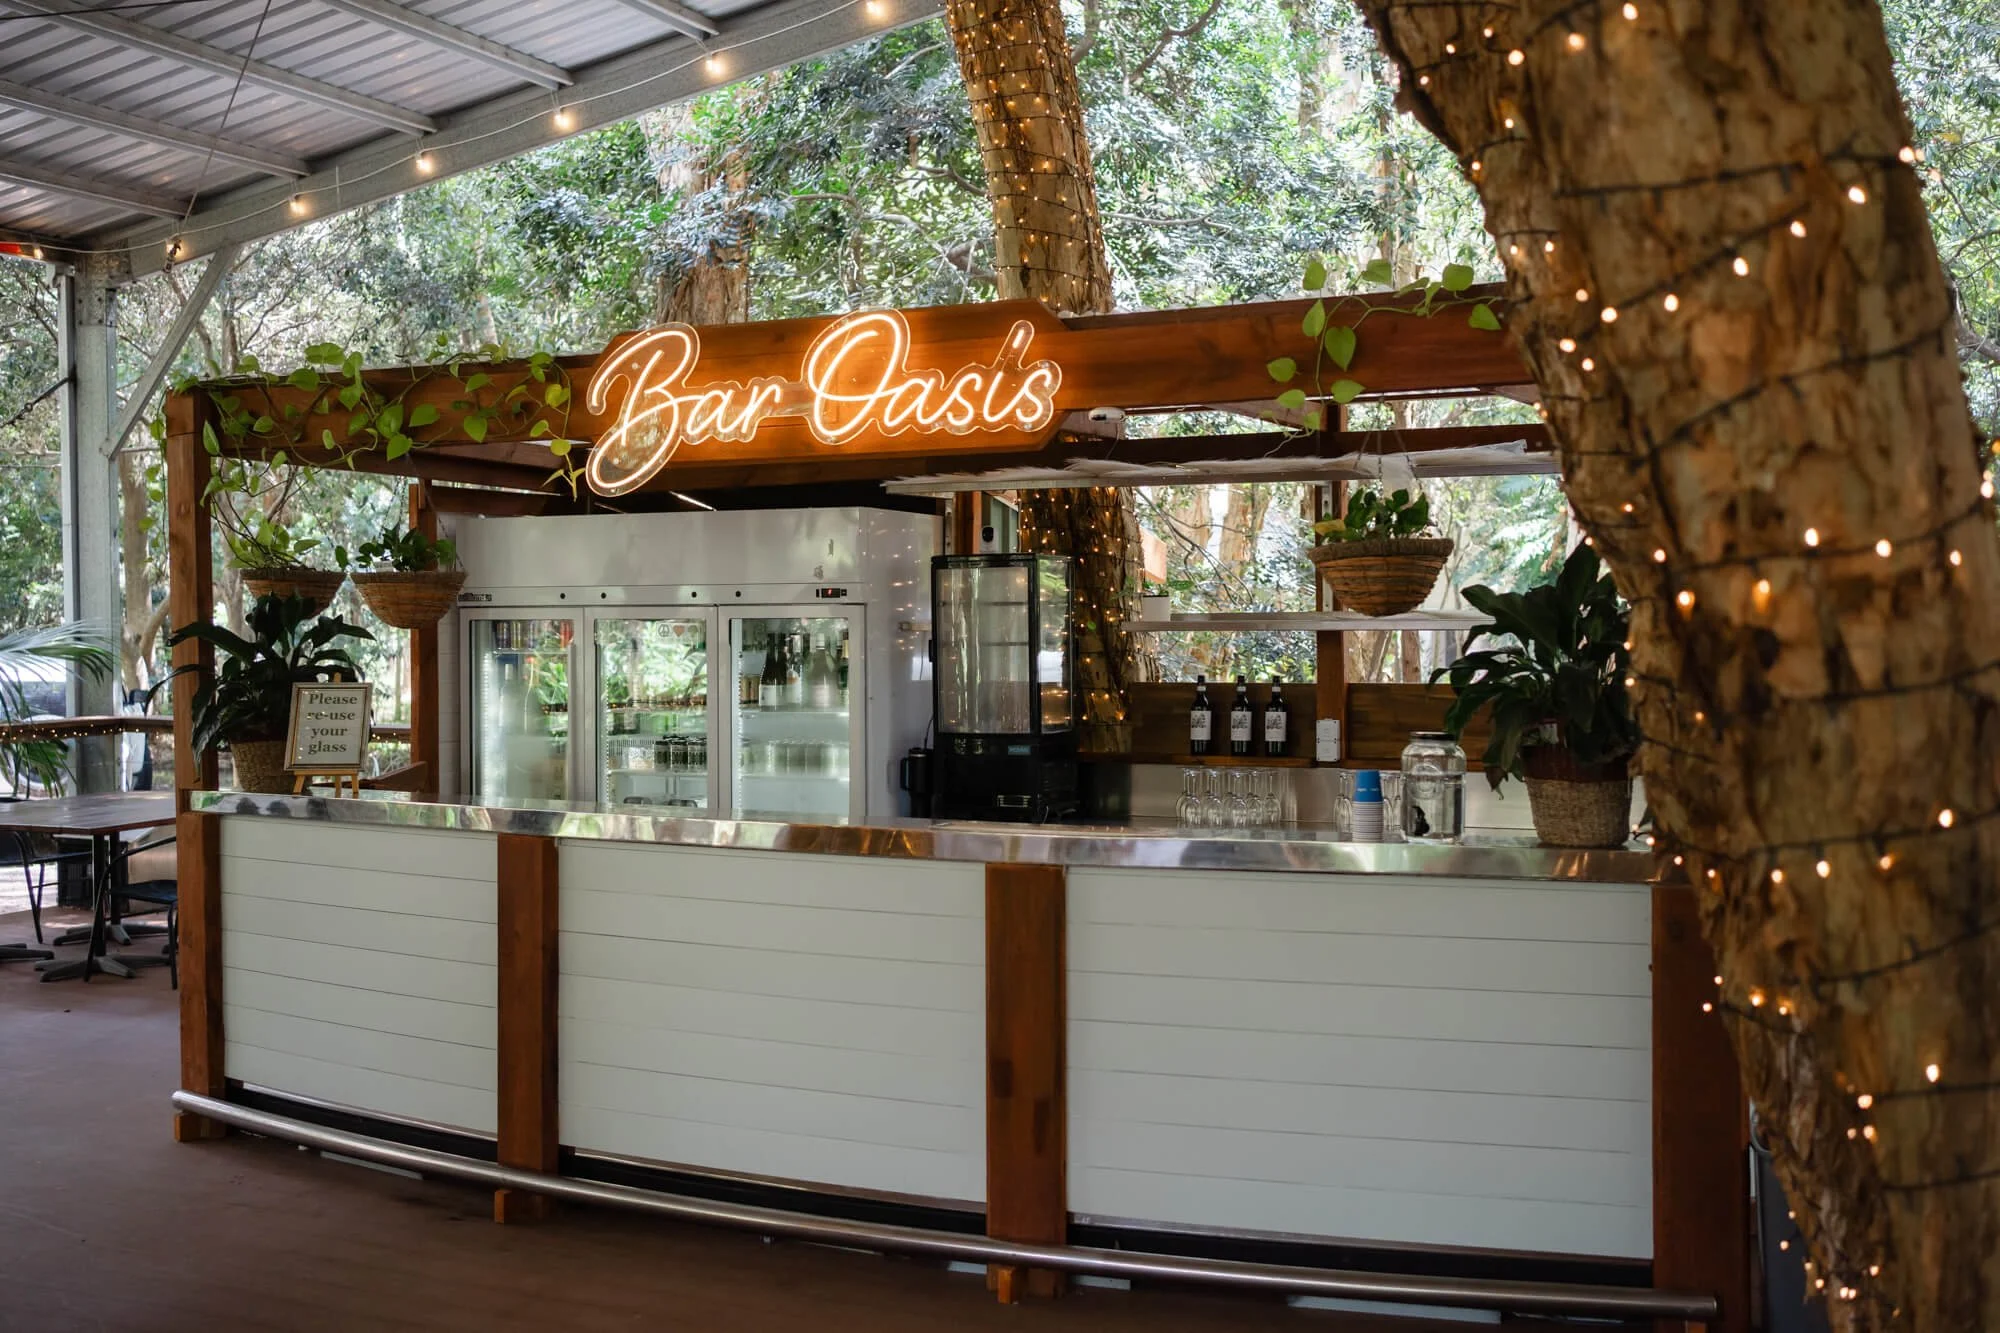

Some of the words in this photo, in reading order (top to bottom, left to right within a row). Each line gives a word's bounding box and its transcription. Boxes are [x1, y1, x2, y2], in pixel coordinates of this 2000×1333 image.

[589, 328, 783, 490] Bar
[806, 312, 1055, 438] Oasis
[308, 692, 358, 705] Please
[306, 711, 356, 721] re-use
[311, 727, 348, 739] your
[307, 740, 347, 756] glass
